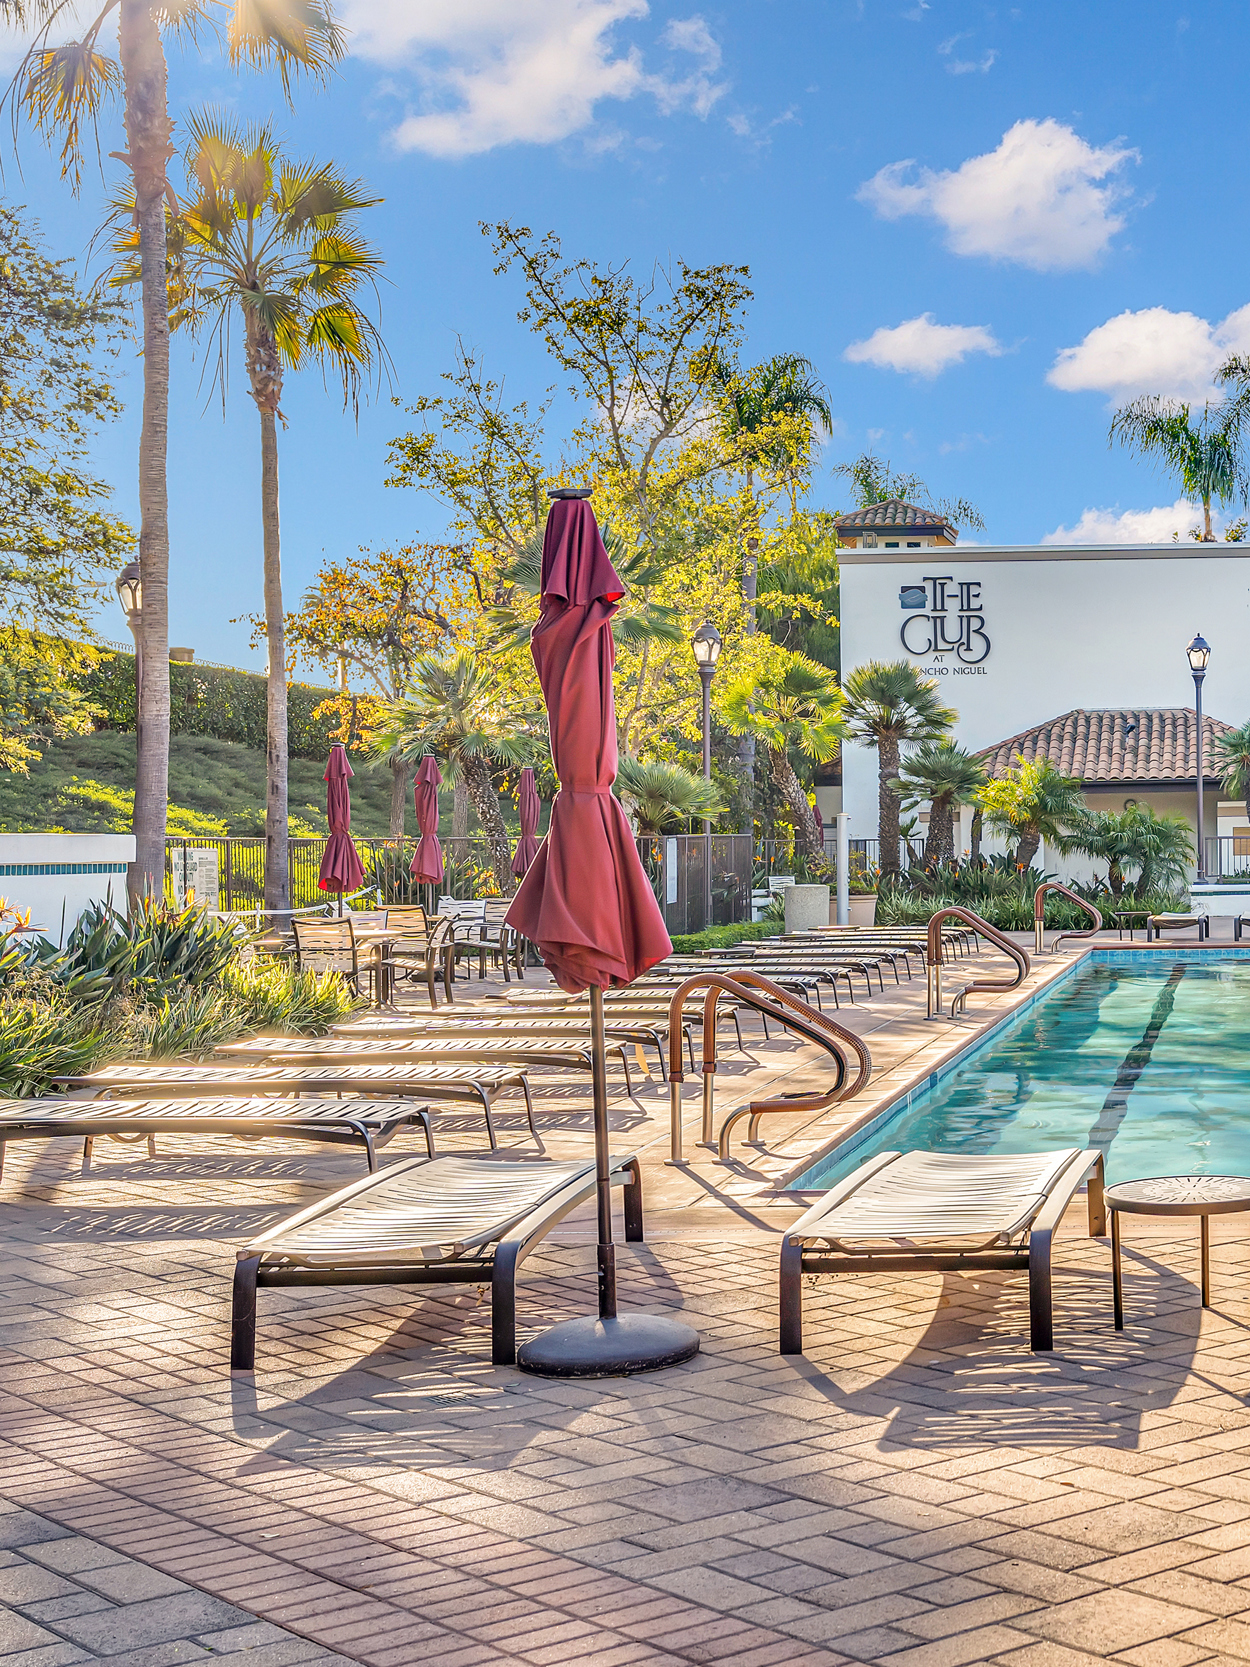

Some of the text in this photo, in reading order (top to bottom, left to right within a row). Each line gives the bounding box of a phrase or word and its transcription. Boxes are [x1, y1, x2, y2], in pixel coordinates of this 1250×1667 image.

[922, 575, 983, 612] THE
[900, 614, 991, 664] CLUB
[933, 654, 945, 663] AT
[919, 667, 987, 676] NCHO NIGUEL
